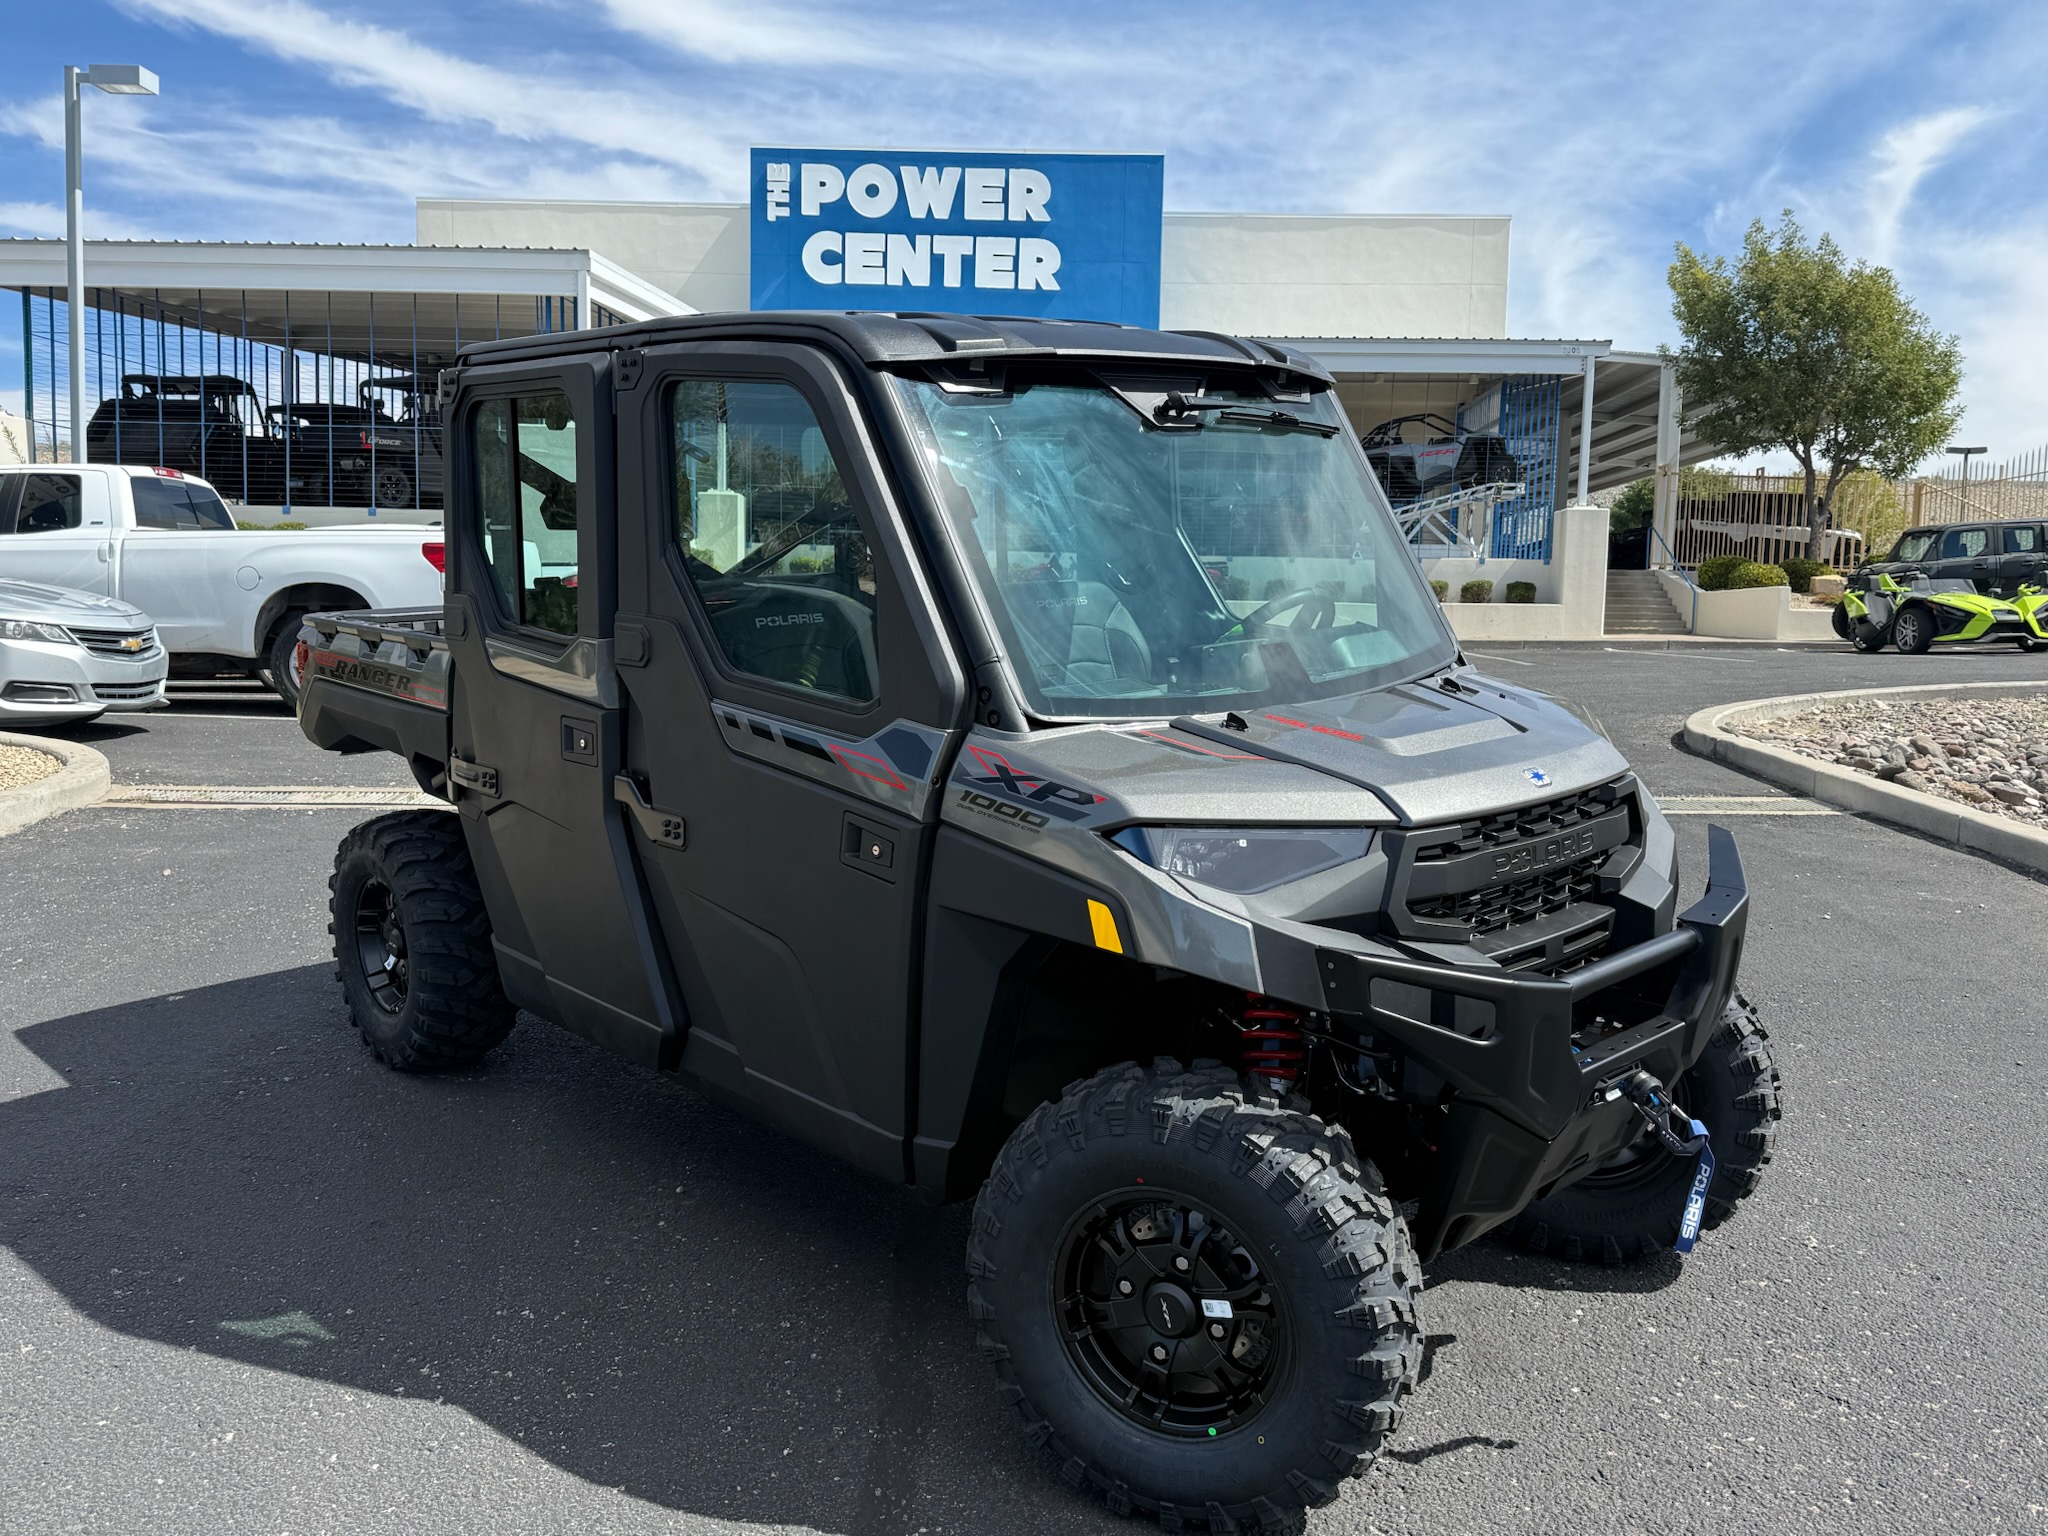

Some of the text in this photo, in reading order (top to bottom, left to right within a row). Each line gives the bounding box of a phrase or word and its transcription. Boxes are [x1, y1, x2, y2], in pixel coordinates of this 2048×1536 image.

[766, 162, 790, 222] THE
[801, 163, 1052, 222] POWER
[801, 230, 1062, 291] CENTER
[755, 613, 824, 628] POLARIS
[1036, 596, 1088, 608] POLARIS
[335, 660, 412, 691] RANGER
[970, 758, 1102, 806] XP
[956, 803, 1041, 835] DUAL OVERHEAD CAM
[959, 790, 1050, 828] 1000
[1491, 828, 1594, 880] POLARIS
[1682, 1163, 1711, 1240] POLARIS
